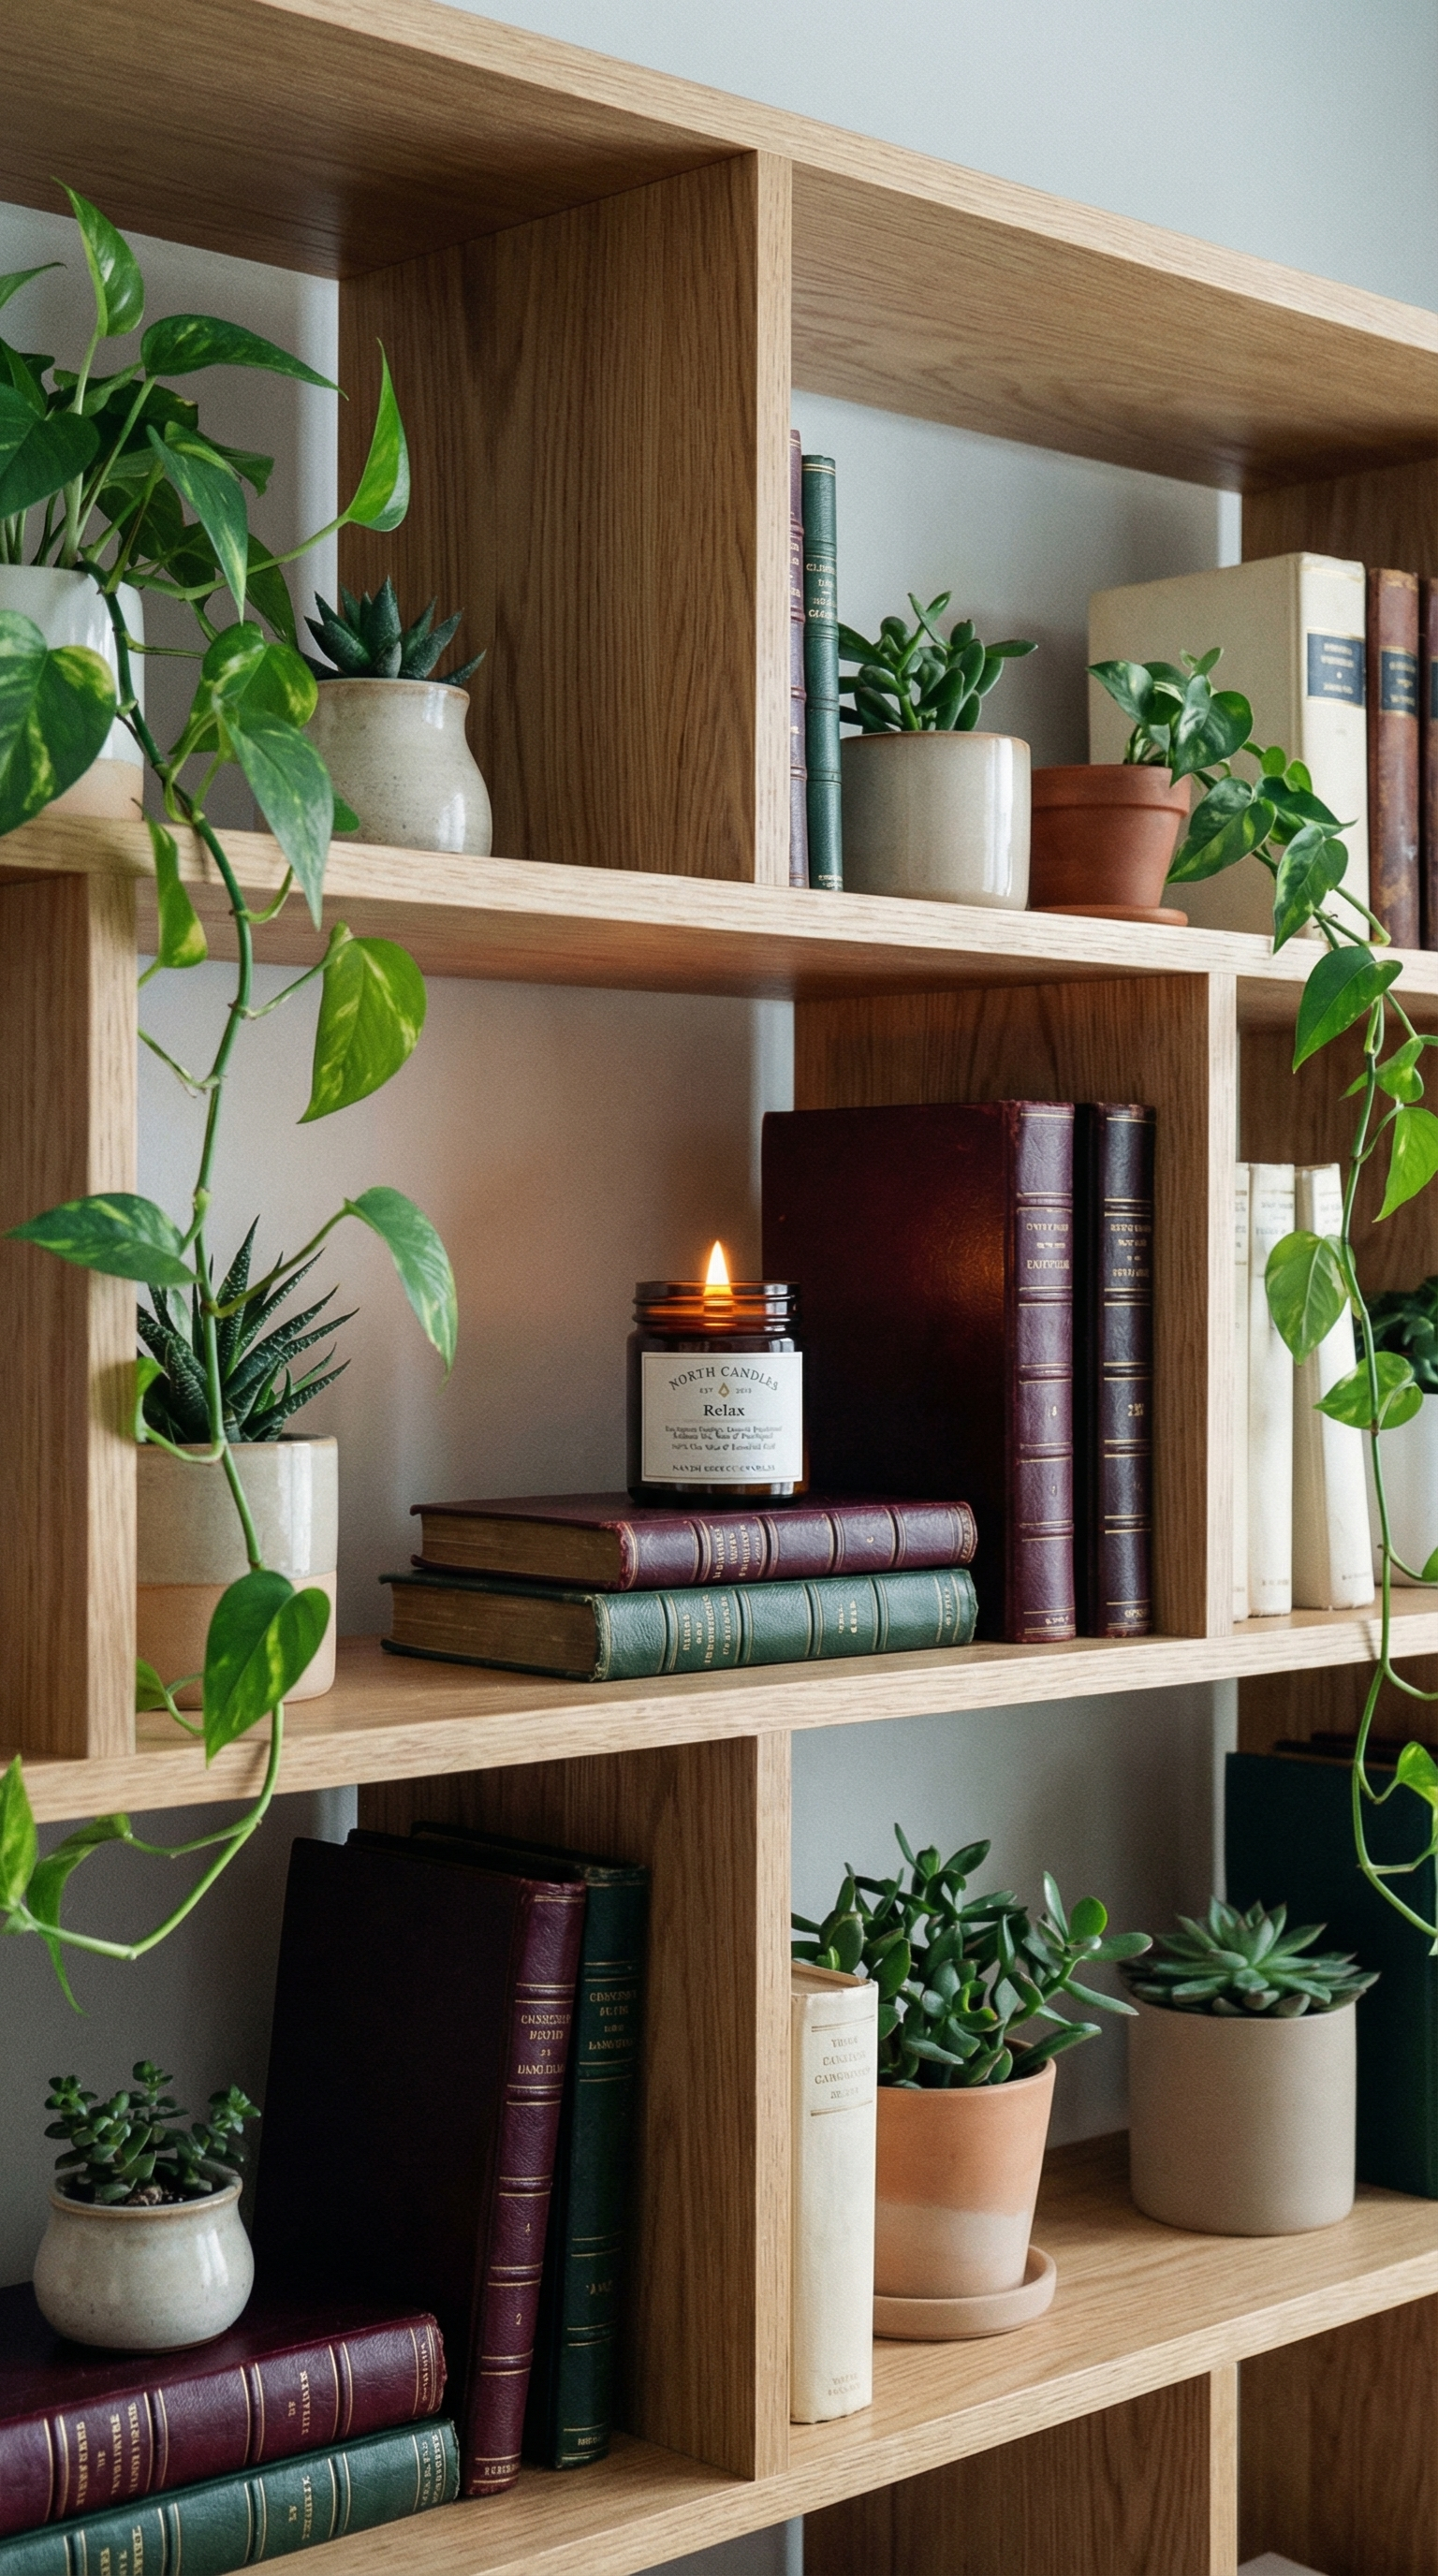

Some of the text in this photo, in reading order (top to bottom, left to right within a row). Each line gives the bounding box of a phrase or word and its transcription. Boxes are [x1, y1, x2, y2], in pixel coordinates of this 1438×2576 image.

[668, 1366, 778, 1391] NORTH CANDLES
[703, 1404, 745, 1416] Relax
